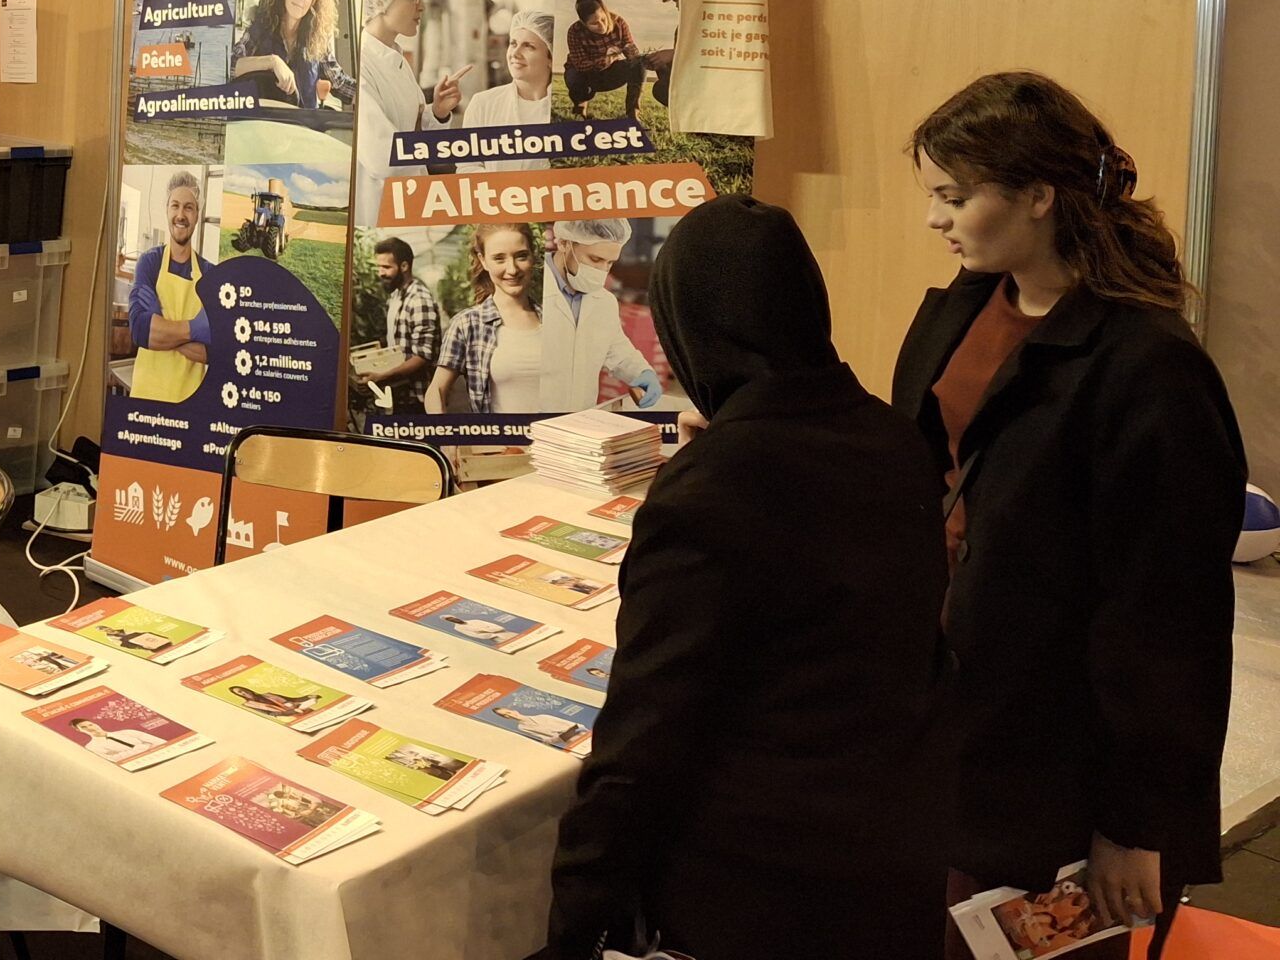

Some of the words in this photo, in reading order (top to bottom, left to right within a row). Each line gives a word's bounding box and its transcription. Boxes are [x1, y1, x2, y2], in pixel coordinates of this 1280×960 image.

[144, 1, 224, 26] Agriculture
[703, 11, 714, 21] Je
[718, 13, 733, 21] ne
[702, 29, 727, 39] Soit
[731, 29, 742, 42] je
[142, 50, 182, 69] Pêche
[701, 47, 725, 57] soit
[138, 91, 255, 117] Agroalimentaire
[395, 137, 430, 161] La
[436, 129, 563, 159] solution
[570, 125, 643, 150] c'est
[391, 177, 706, 220] l'Alternance
[240, 287, 252, 298] 50
[240, 300, 262, 308] branches
[263, 302, 307, 312] professionnelles
[254, 321, 270, 333] 184
[271, 322, 291, 334] 598
[254, 335, 282, 345] entreprises
[255, 355, 268, 367] 1,2
[270, 356, 312, 371] millions
[283, 372, 308, 382] couverts
[249, 387, 261, 400] de
[263, 390, 281, 402] 150
[241, 402, 261, 411] métiers
[128, 411, 189, 429] #Compétences
[372, 423, 500, 439] Rejoignez-nous
[117, 430, 182, 450] #Apprentissage
